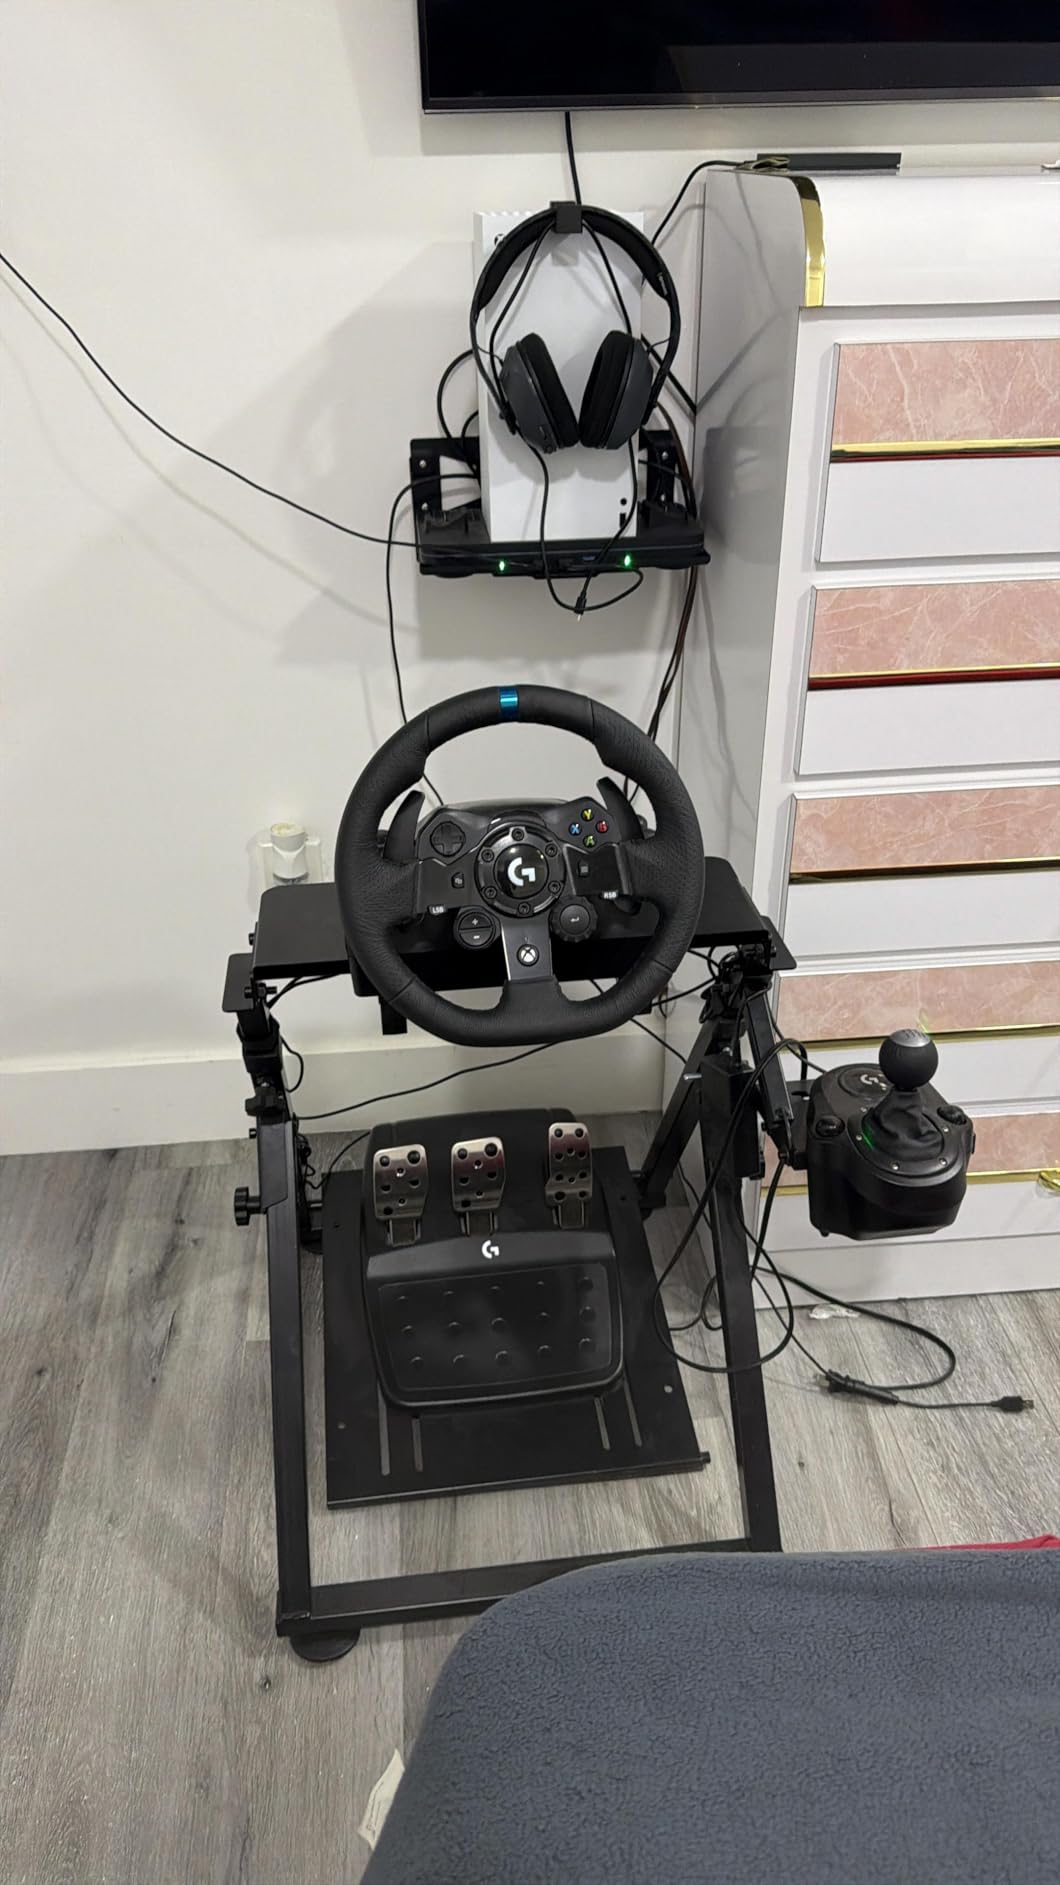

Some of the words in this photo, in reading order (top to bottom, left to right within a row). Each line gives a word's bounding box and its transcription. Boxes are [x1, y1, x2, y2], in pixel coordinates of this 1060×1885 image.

[583, 809, 592, 820] Y
[571, 823, 580, 834] X
[586, 836, 595, 846] A
